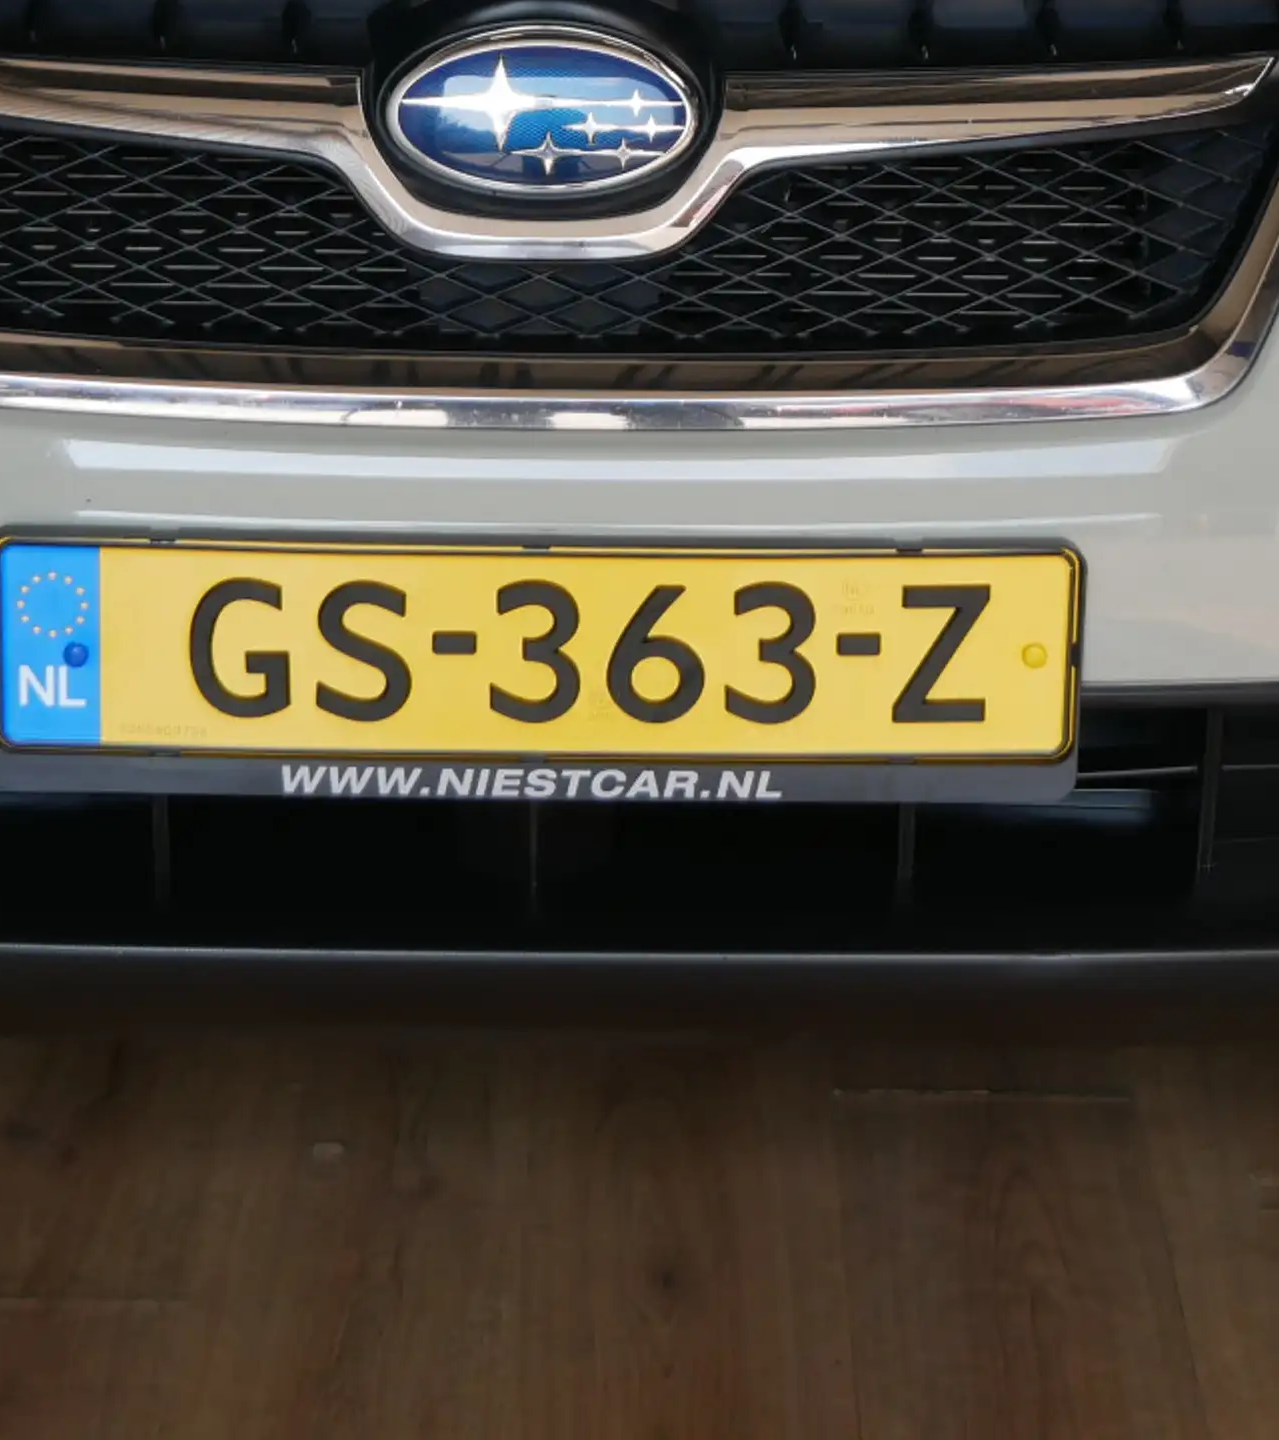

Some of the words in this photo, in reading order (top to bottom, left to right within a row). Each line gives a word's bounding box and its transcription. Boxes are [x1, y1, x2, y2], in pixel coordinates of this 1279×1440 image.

[188, 578, 993, 725] GS-363-Z
[18, 664, 88, 707] NL
[281, 764, 783, 800] WWW.NIESTCAR.NL
